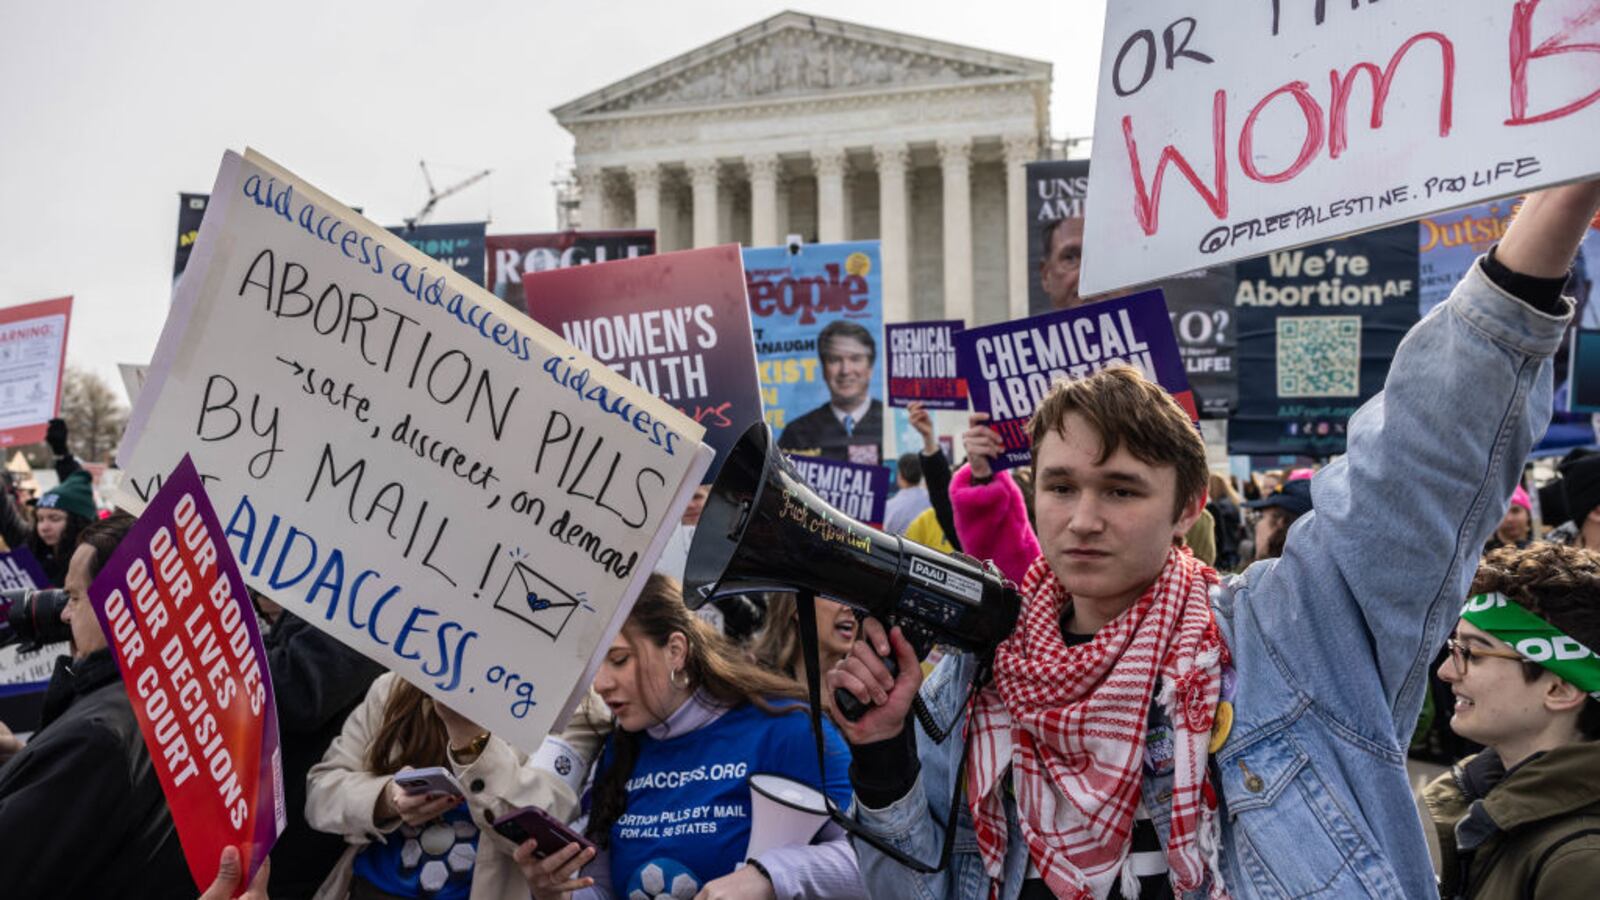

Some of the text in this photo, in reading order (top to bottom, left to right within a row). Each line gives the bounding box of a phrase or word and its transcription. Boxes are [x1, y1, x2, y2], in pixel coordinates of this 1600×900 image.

[1112, 17, 1215, 97] OR
[1268, 248, 1370, 278] We're
[746, 263, 869, 325] eople
[562, 304, 718, 361] WOMEN'S
[890, 326, 956, 353] CHEMICAL
[975, 308, 1149, 381] CHEMICAL
[238, 249, 519, 441] ABORTION
[535, 410, 665, 529] PILLS
[892, 352, 957, 378] ABORTION
[1186, 356, 1231, 372] LIFE!
[303, 369, 380, 438] safe,
[391, 414, 501, 509] discreet,
[511, 490, 546, 526] on
[789, 458, 875, 496] HEMICAL
[914, 562, 945, 582] PAAU
[149, 525, 237, 710] OUR LIVES
[173, 492, 267, 717] OUR BODIES
[104, 588, 199, 788] OUR COURT
[126, 557, 248, 830] OUR DECISIONS
[617, 804, 747, 827] ORTION PILLS BY MAIL
[620, 822, 717, 839] FOR ALL 50 STATES
